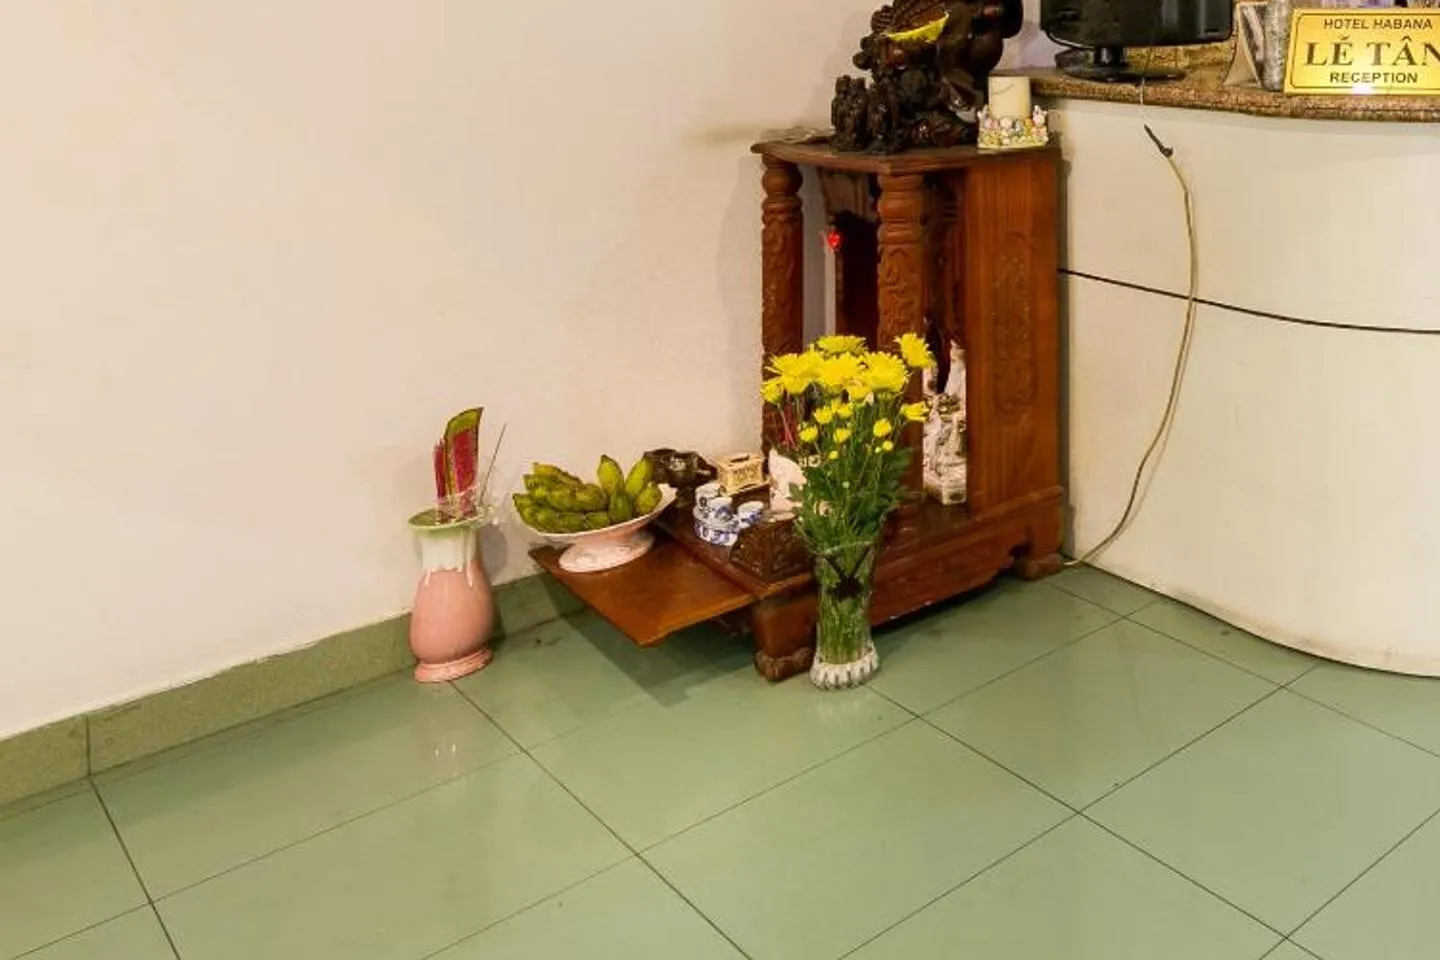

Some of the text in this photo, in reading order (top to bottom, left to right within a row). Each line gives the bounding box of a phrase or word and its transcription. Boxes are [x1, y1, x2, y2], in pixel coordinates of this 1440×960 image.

[1324, 18, 1433, 30] HOTEL HABANA
[1330, 72, 1418, 84] RECEPTION
